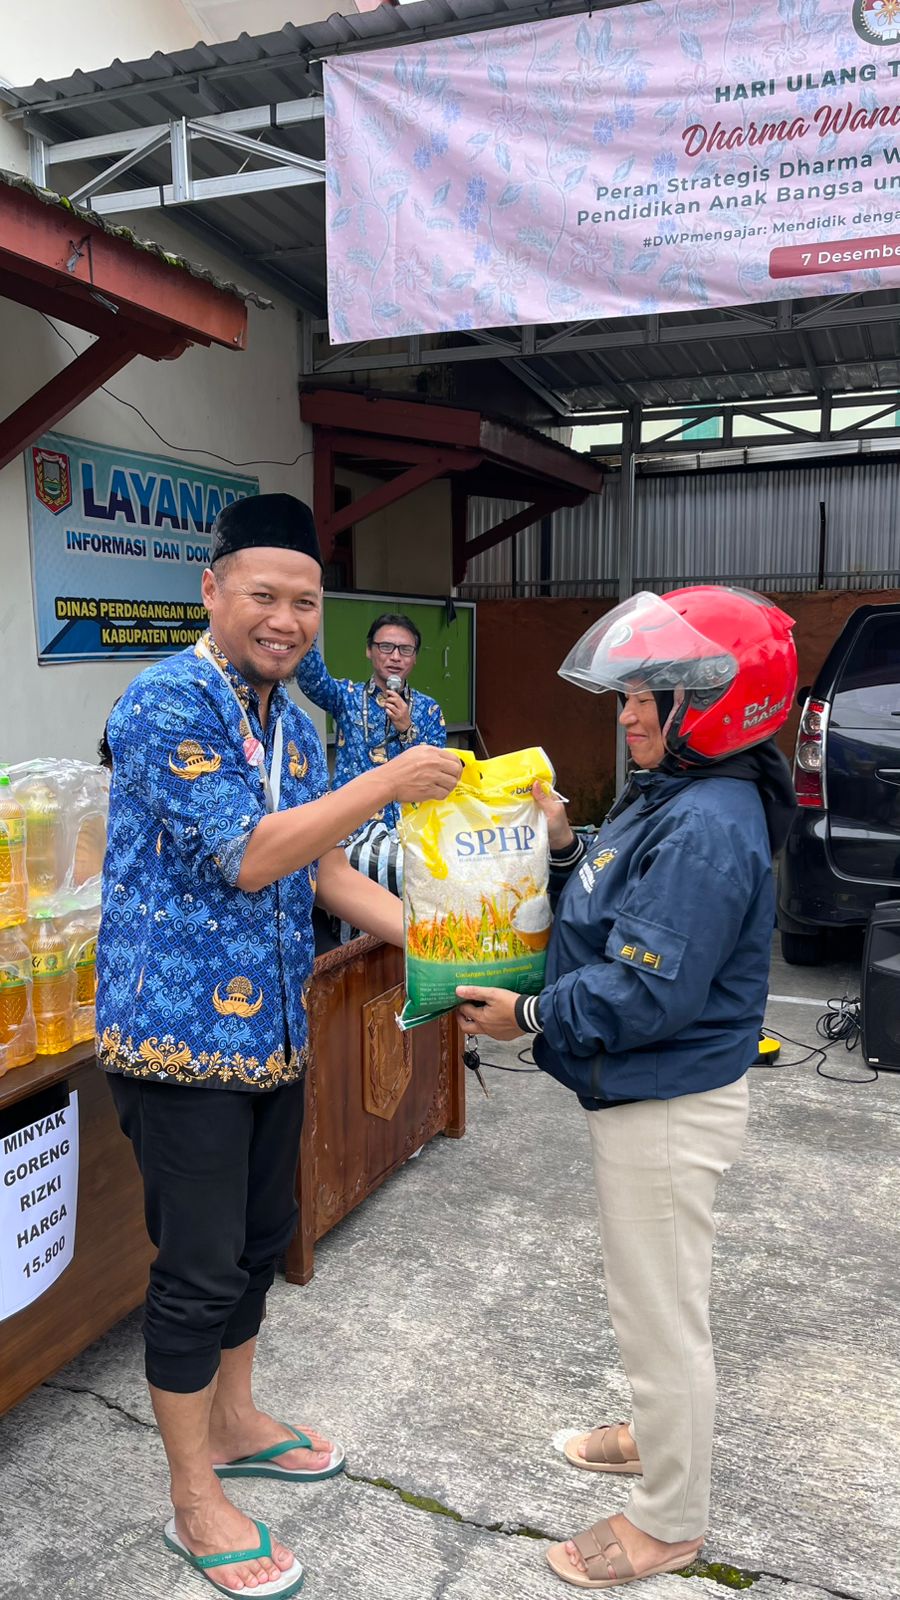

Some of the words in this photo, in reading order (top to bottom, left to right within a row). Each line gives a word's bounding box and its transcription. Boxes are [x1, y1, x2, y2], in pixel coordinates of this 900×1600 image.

[715, 79, 775, 103] HARI
[787, 64, 876, 92] ULANG
[682, 115, 810, 157] Dharma
[596, 183, 658, 201] Peran
[667, 165, 770, 194] Strategis
[779, 152, 873, 179] Dharma
[577, 199, 700, 226] Pendidikan
[709, 186, 767, 211] Anak
[777, 179, 863, 203] Bangsa
[643, 223, 767, 248] #DWPmengajar:
[772, 214, 847, 234] Mendidik
[801, 253, 812, 266] 7
[80, 461, 247, 535] LAYANA
[66, 531, 147, 557] INFORMASI
[153, 541, 180, 563] DAN
[186, 545, 211, 563] DOK
[57, 601, 98, 617] DINAS
[100, 602, 185, 619] PERDAGANGAN
[102, 629, 168, 644] KABUPATEN
[170, 630, 205, 644] WONO
[744, 696, 769, 717] DJ
[455, 825, 535, 857] SPHP
[483, 936, 493, 953] 5
[3, 1110, 66, 1155] MINYAK
[4, 1139, 70, 1187] GORENG
[20, 1175, 62, 1212] RIZKI
[17, 1204, 68, 1249] HARGA
[23, 1235, 65, 1278] 15.800
